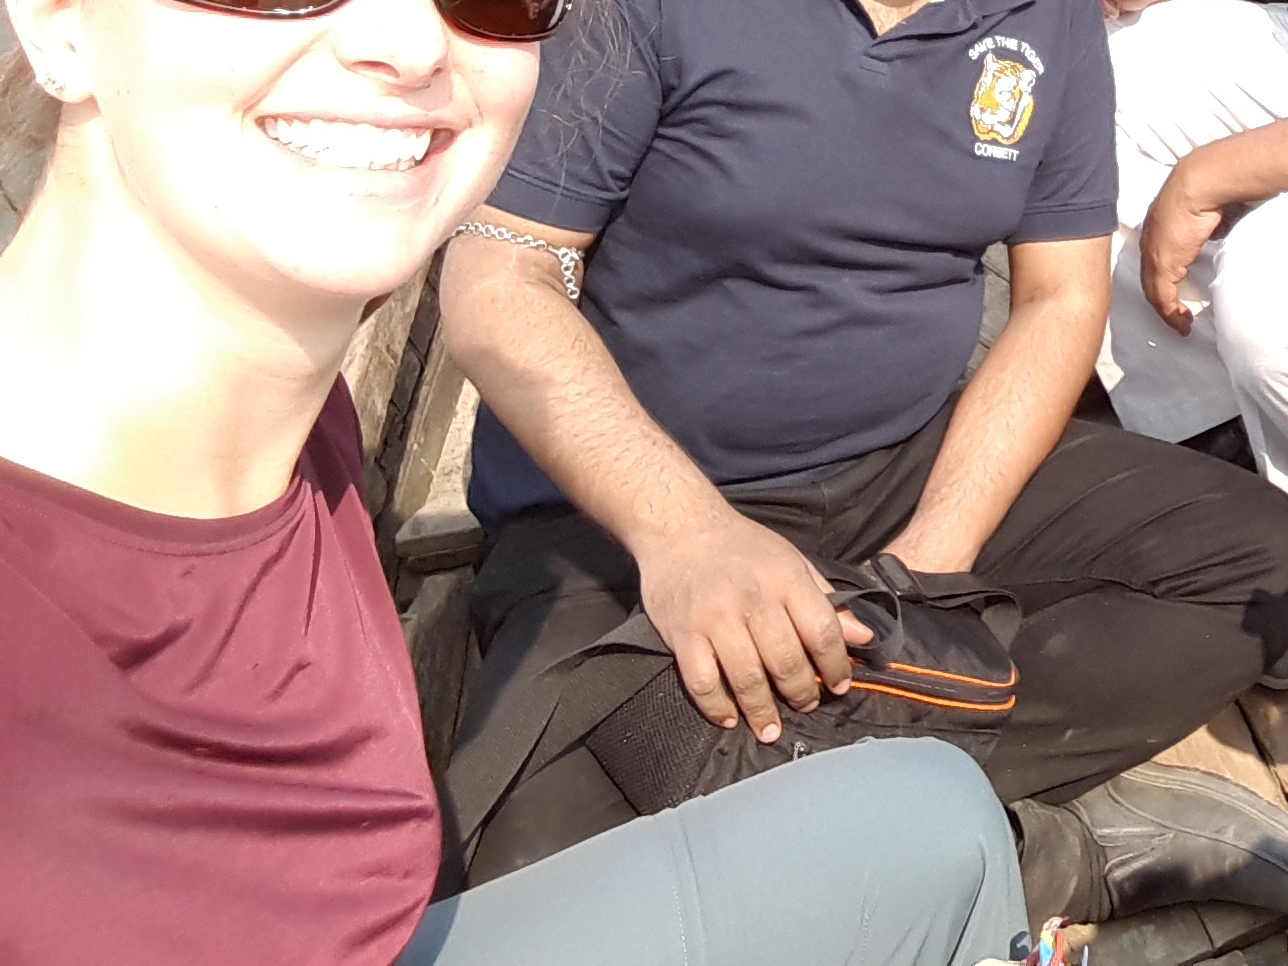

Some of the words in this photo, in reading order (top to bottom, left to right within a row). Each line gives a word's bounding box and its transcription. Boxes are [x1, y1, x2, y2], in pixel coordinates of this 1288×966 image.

[969, 38, 995, 60] SAVE
[995, 36, 1018, 50] THE
[1021, 42, 1044, 75] TIGER
[975, 143, 1019, 161] CORBETT
